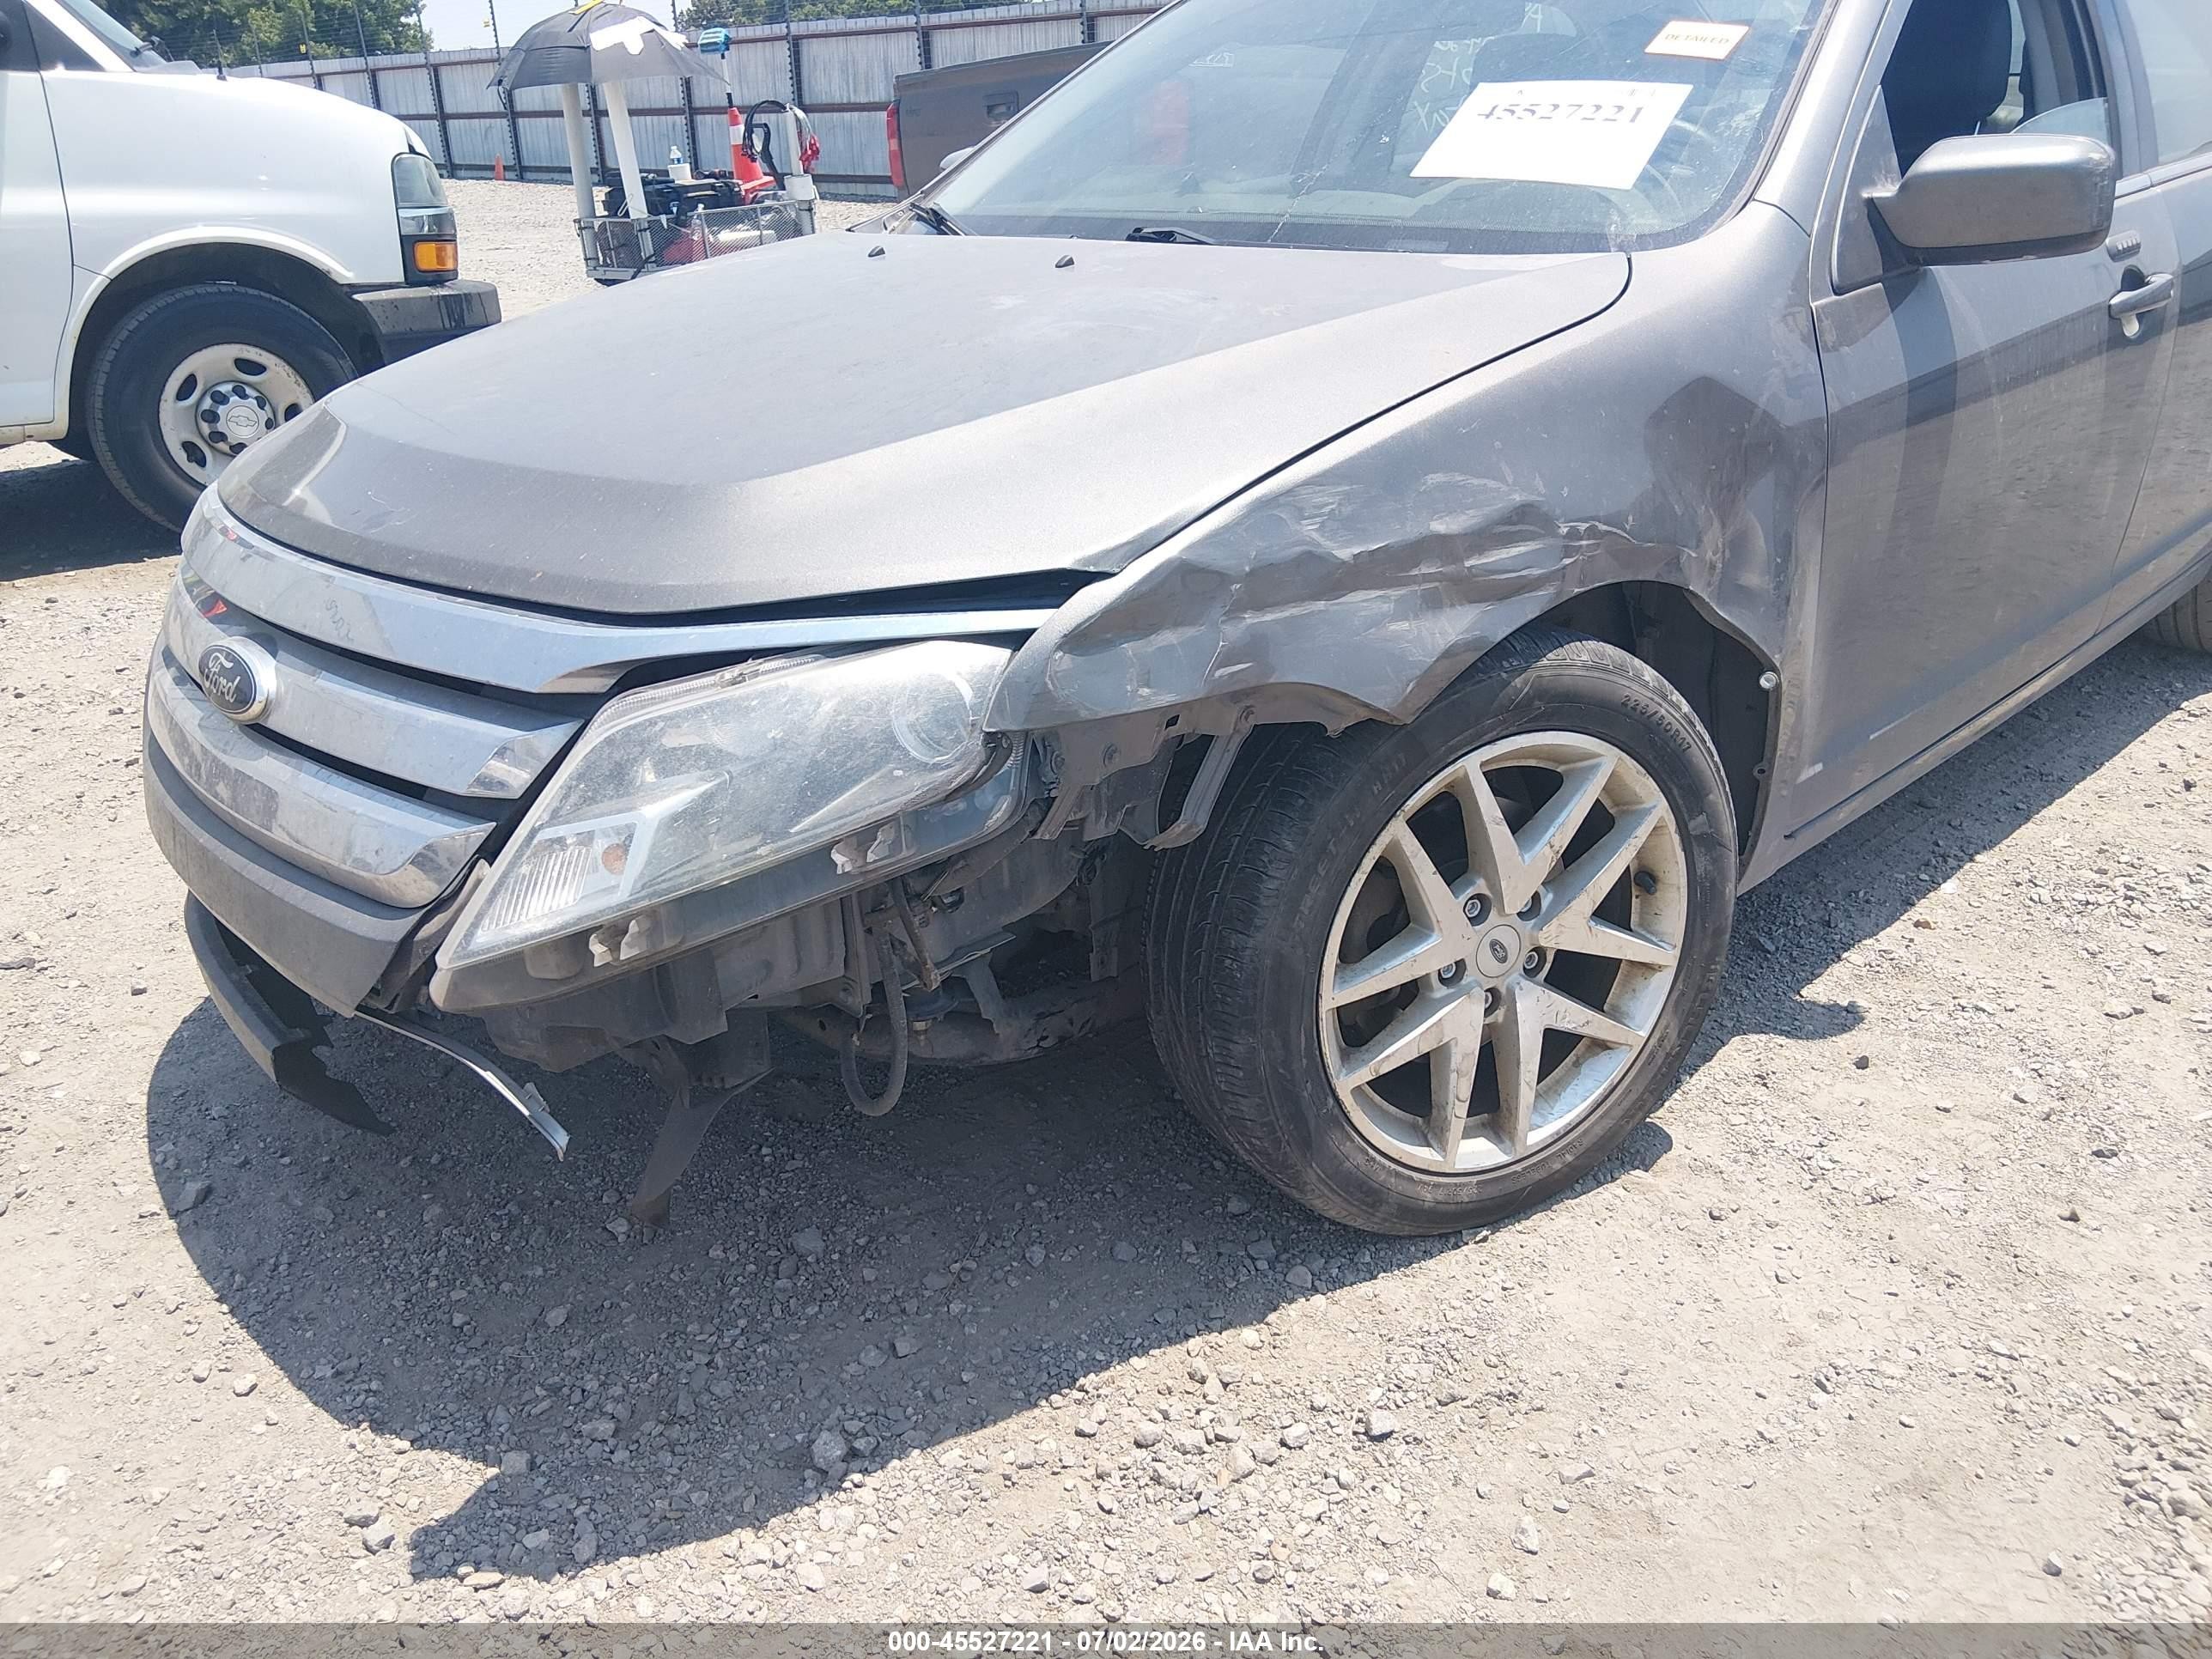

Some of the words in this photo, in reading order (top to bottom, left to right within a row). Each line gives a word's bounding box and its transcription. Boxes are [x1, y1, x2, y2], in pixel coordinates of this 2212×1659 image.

[1663, 33, 1730, 46] DETAILED
[1477, 103, 1645, 124] 45527221
[204, 652, 241, 703] Ford
[1620, 692, 1692, 754] 225/50R17
